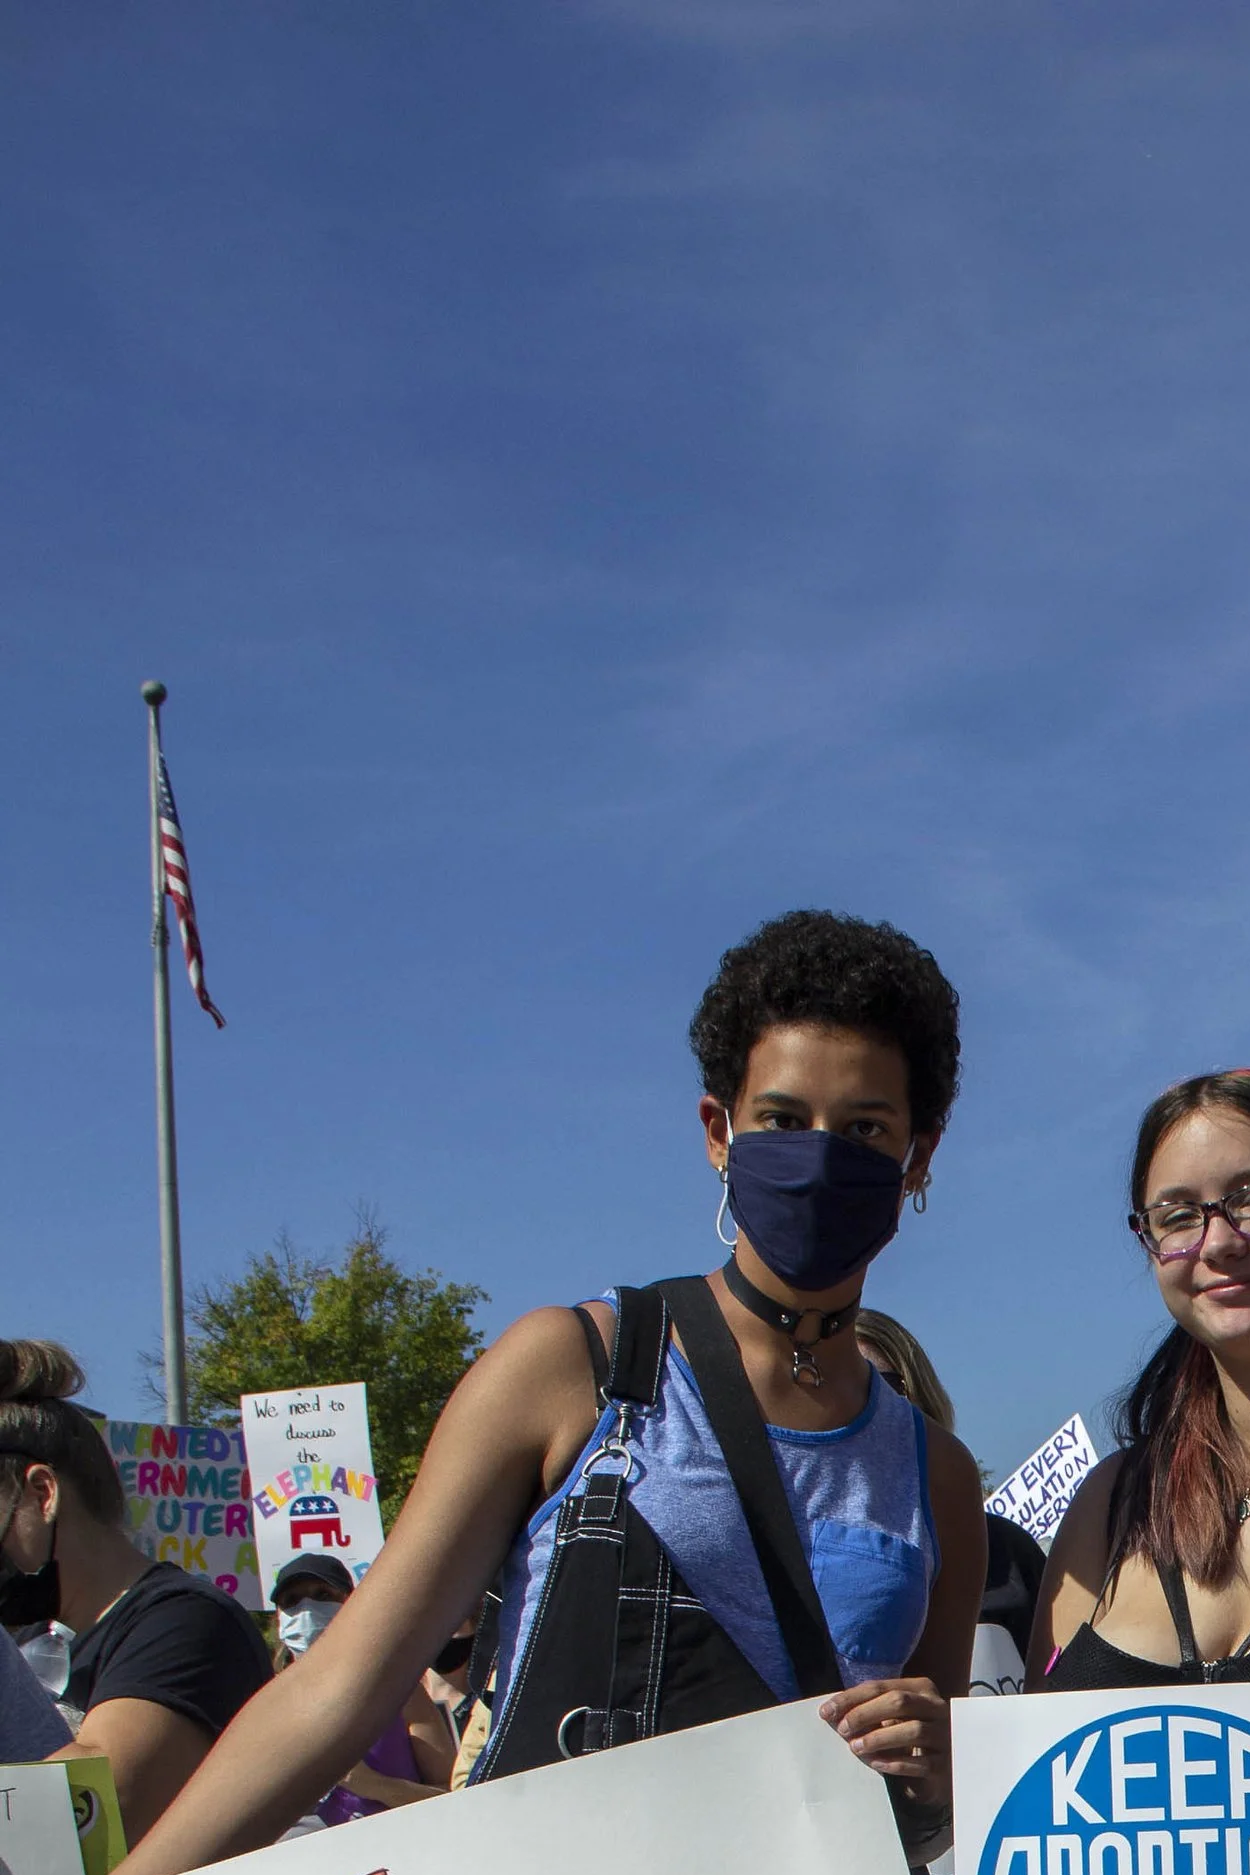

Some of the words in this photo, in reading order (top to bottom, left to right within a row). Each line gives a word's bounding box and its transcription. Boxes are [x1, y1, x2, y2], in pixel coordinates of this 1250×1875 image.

[254, 1398, 279, 1419] We
[289, 1394, 321, 1416] need
[329, 1400, 345, 1412] to
[110, 1421, 231, 1462] WANTED
[286, 1423, 337, 1441] discuss
[296, 1447, 322, 1464] the
[1020, 1420, 1079, 1491] EVERY
[115, 1459, 251, 1501] ERNME
[253, 1463, 378, 1520] ELEPHANT
[1010, 1448, 1090, 1527] ULATION
[156, 1499, 255, 1538] UTER
